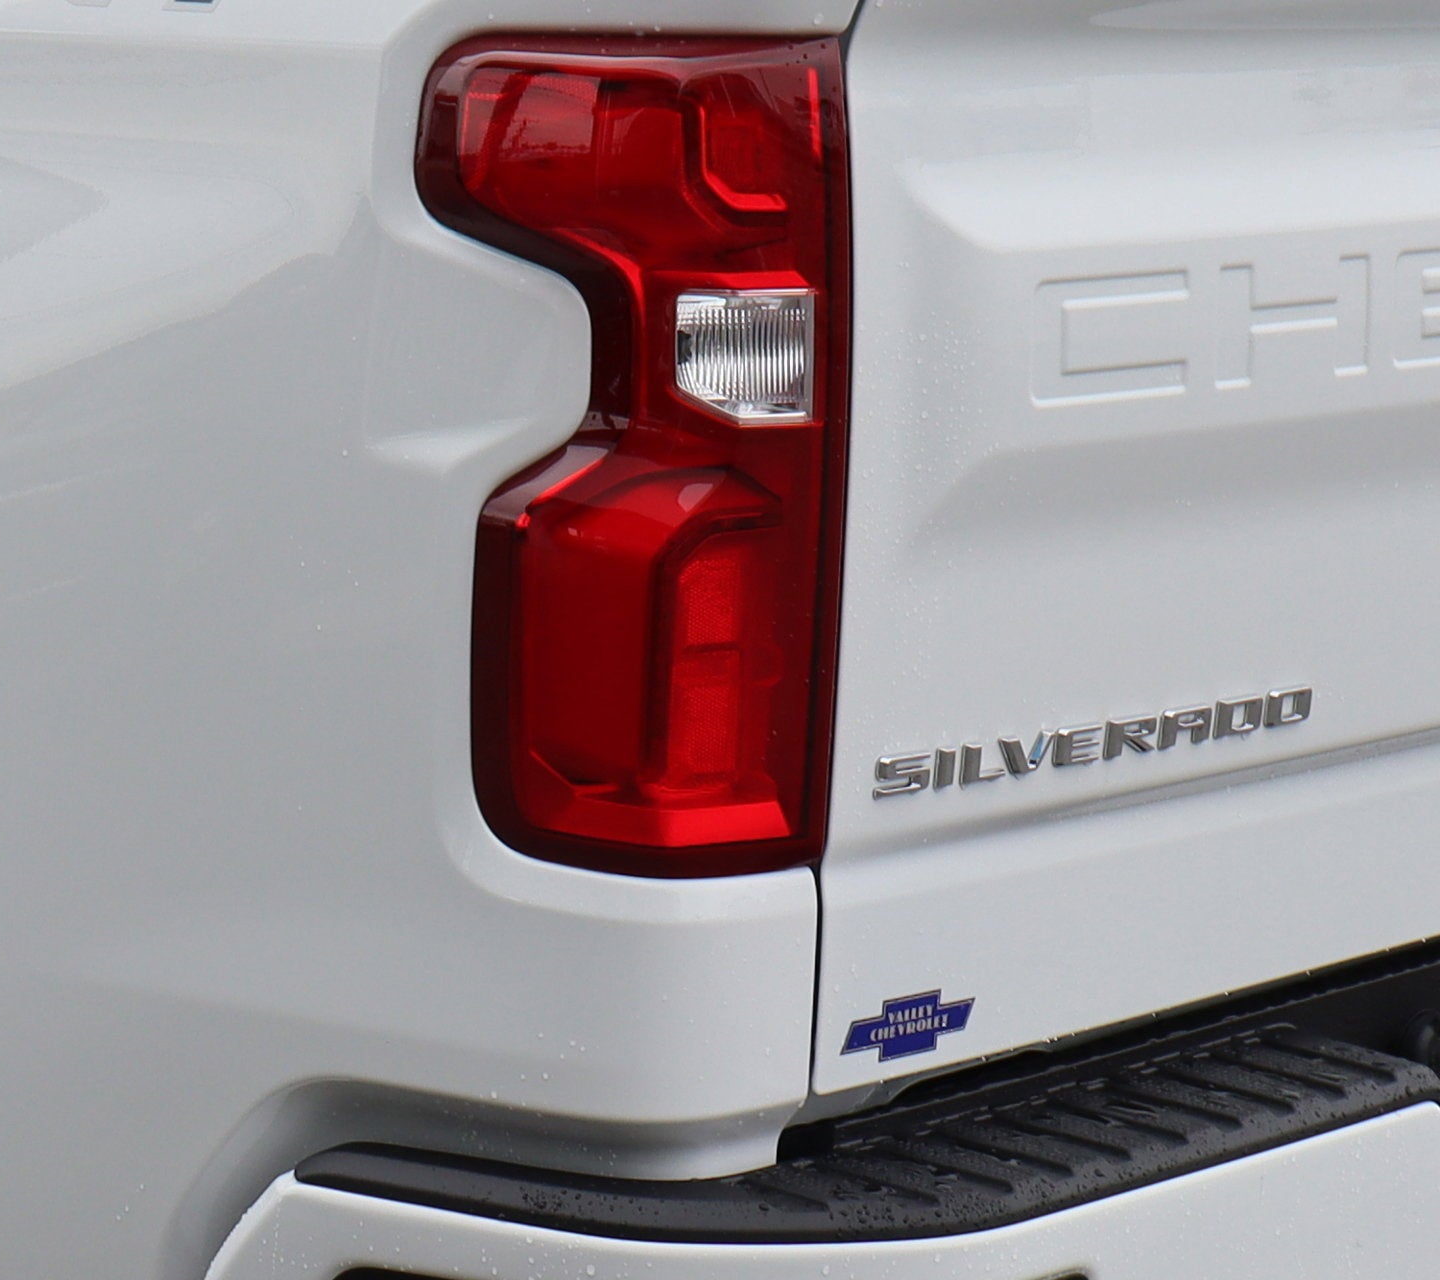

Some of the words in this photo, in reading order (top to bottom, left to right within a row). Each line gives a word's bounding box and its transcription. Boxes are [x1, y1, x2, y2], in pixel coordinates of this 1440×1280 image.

[872, 685, 1313, 802] SILVERADO
[869, 1013, 949, 1042] CHEVROLET
[887, 1004, 934, 1025] VALLEY
